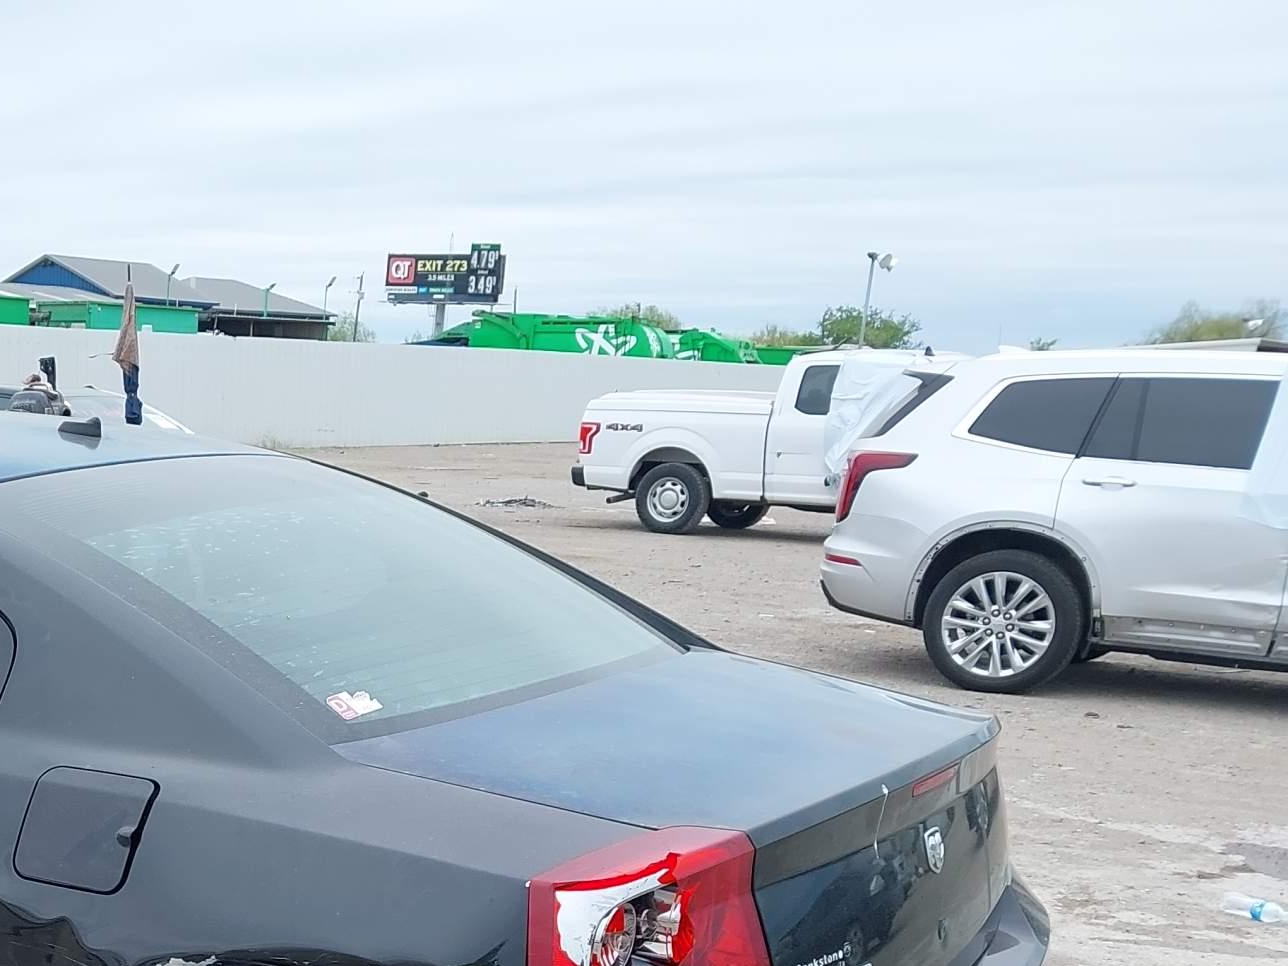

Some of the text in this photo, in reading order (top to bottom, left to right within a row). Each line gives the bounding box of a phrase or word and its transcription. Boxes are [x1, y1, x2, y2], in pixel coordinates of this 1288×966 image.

[392, 261, 412, 280] QT
[417, 259, 468, 272] EXIT 273
